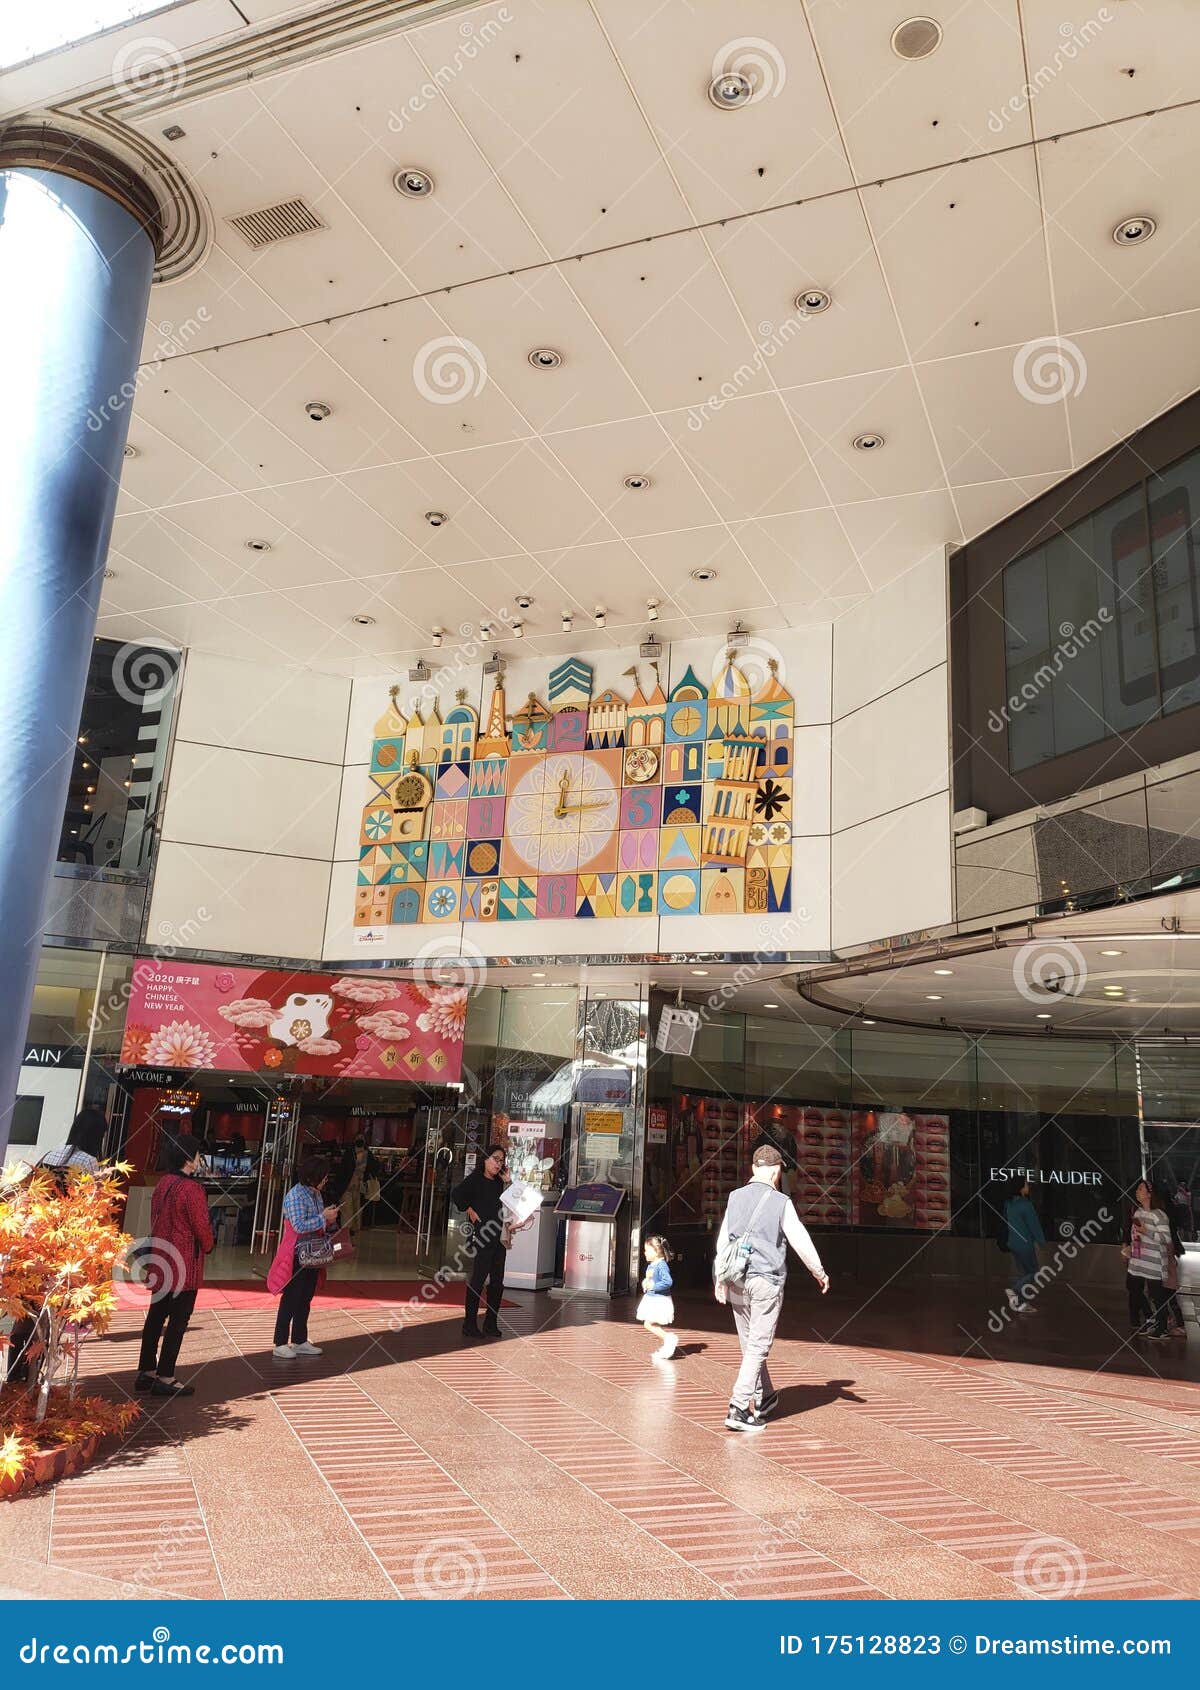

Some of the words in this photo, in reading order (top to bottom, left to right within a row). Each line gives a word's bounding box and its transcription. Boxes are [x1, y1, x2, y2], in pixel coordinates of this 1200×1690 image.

[627, 788, 653, 826] 3
[477, 800, 494, 835] 9
[547, 878, 567, 914] 6
[148, 974, 174, 983] 2020
[146, 984, 173, 992] HAPPY
[145, 993, 180, 1002] CHINESE
[144, 1002, 163, 1010] NEW
[165, 1003, 185, 1011] YEAR
[1040, 1169, 1103, 1186] LAUDER
